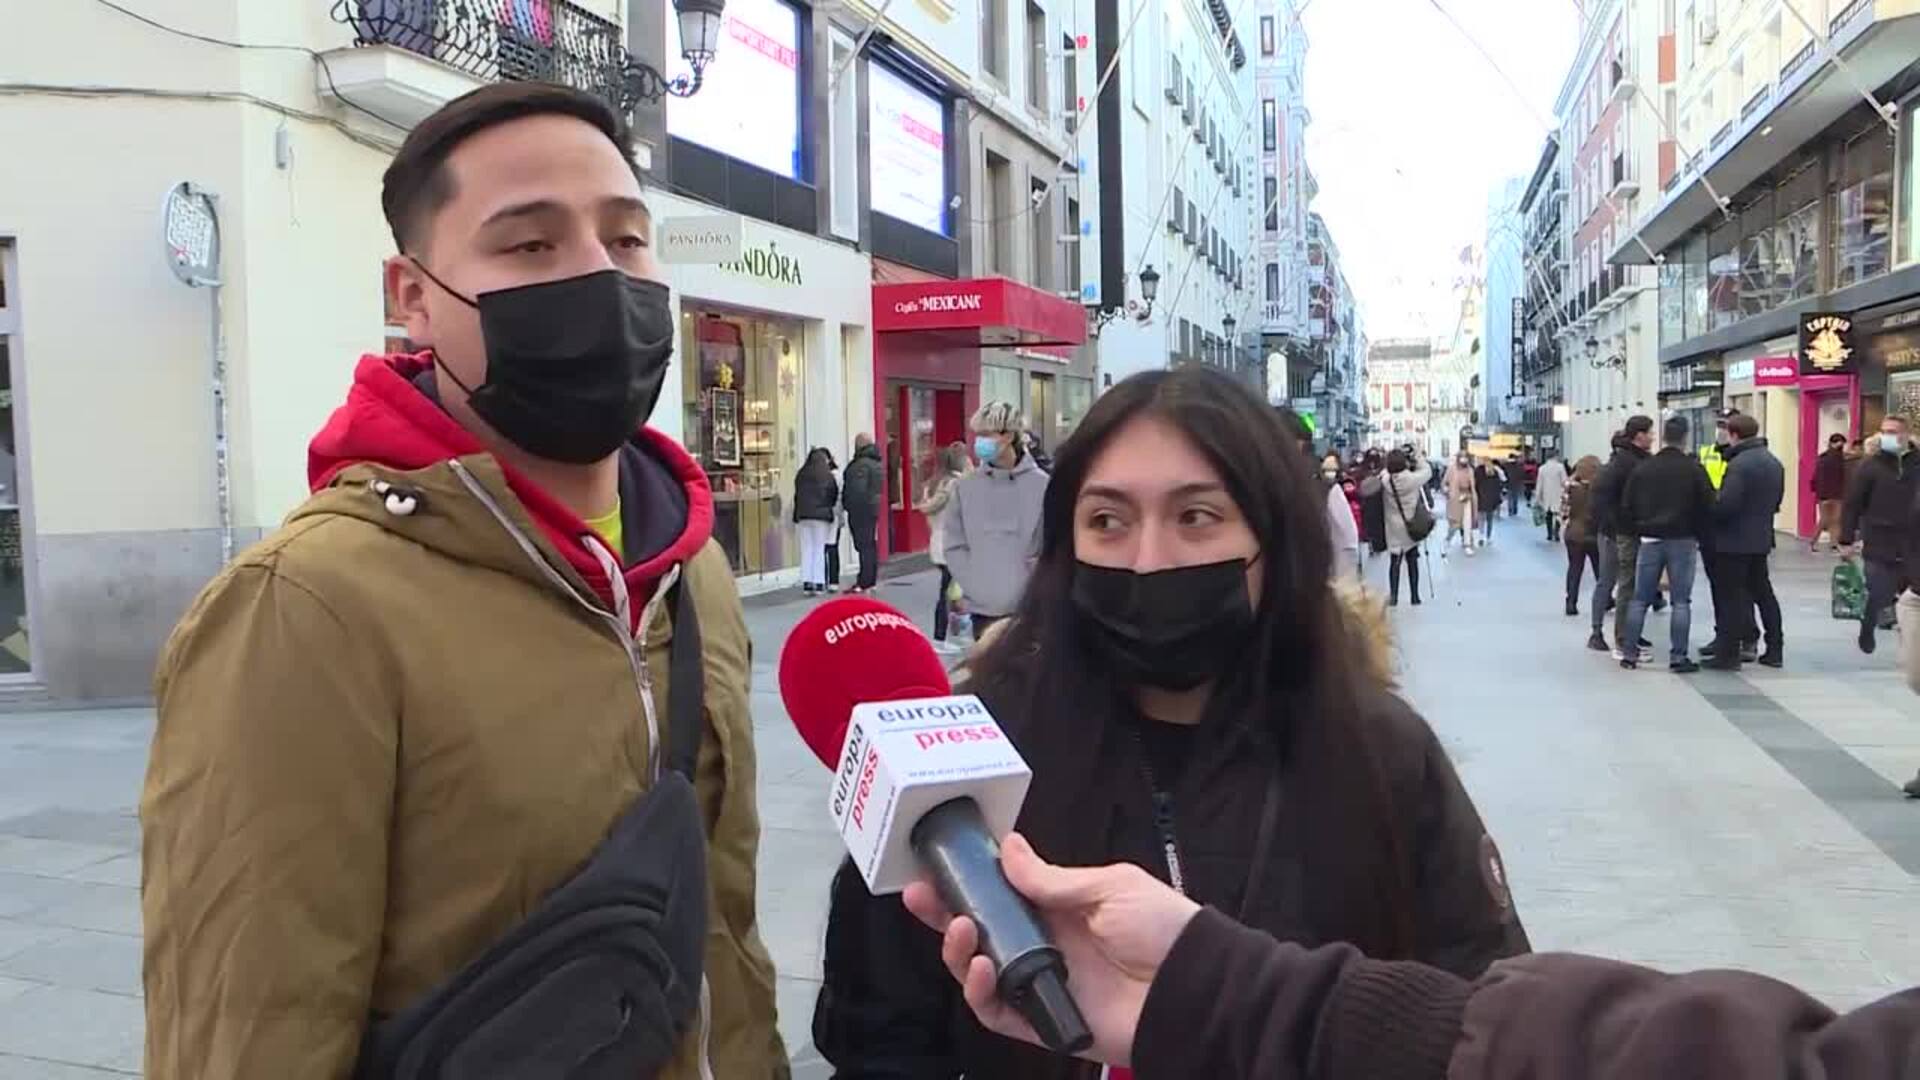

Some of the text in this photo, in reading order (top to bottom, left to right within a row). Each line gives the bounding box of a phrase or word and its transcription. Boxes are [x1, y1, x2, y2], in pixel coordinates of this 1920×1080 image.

[718, 240, 802, 286] NDORA
[877, 700, 982, 720] europa
[914, 726, 999, 751] press
[832, 723, 864, 817] europa
[851, 747, 880, 831] press
